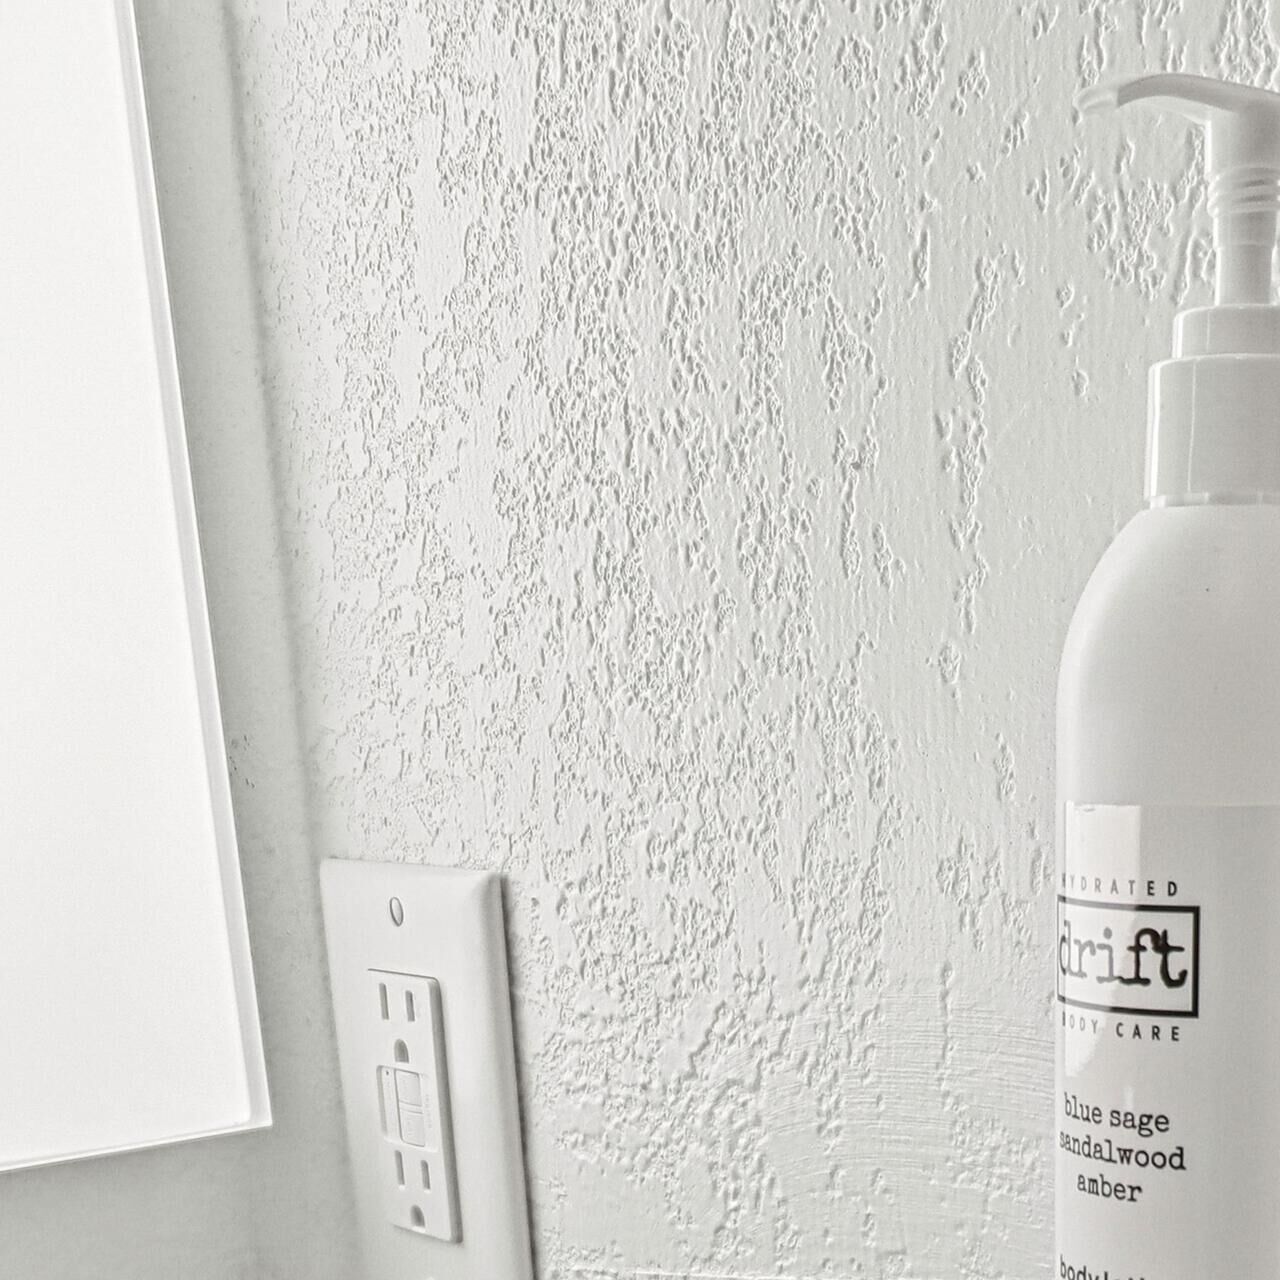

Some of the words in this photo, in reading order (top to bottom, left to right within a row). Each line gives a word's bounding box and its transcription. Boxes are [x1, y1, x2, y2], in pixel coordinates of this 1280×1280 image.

[1058, 919, 1189, 989] drift
[1115, 1022, 1181, 1042] CARE
[1064, 1091, 1103, 1125] blue
[1108, 1108, 1171, 1138] sage
[1058, 1130, 1187, 1172] sandalwood
[1076, 1173, 1143, 1203] amber
